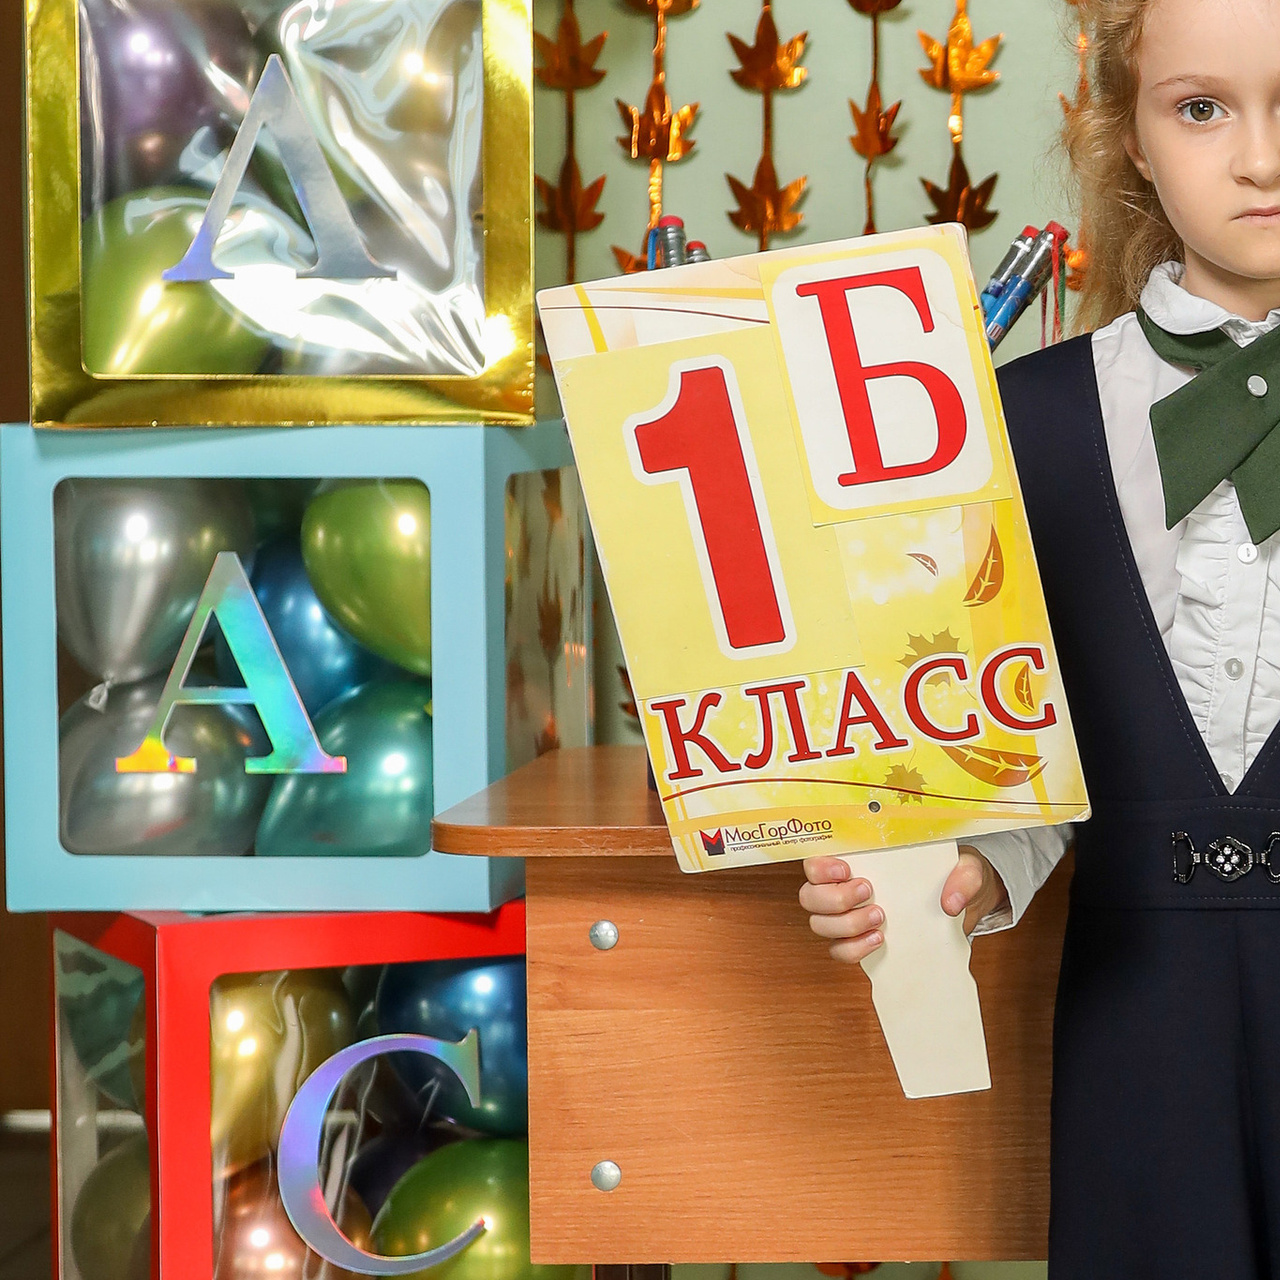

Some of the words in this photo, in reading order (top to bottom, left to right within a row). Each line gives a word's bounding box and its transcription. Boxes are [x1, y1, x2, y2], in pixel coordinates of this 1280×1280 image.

[634, 365, 787, 650] 1
[797, 265, 968, 487] Б
[649, 645, 1058, 782] КЛАСС
[725, 818, 832, 843] МосГорФото
